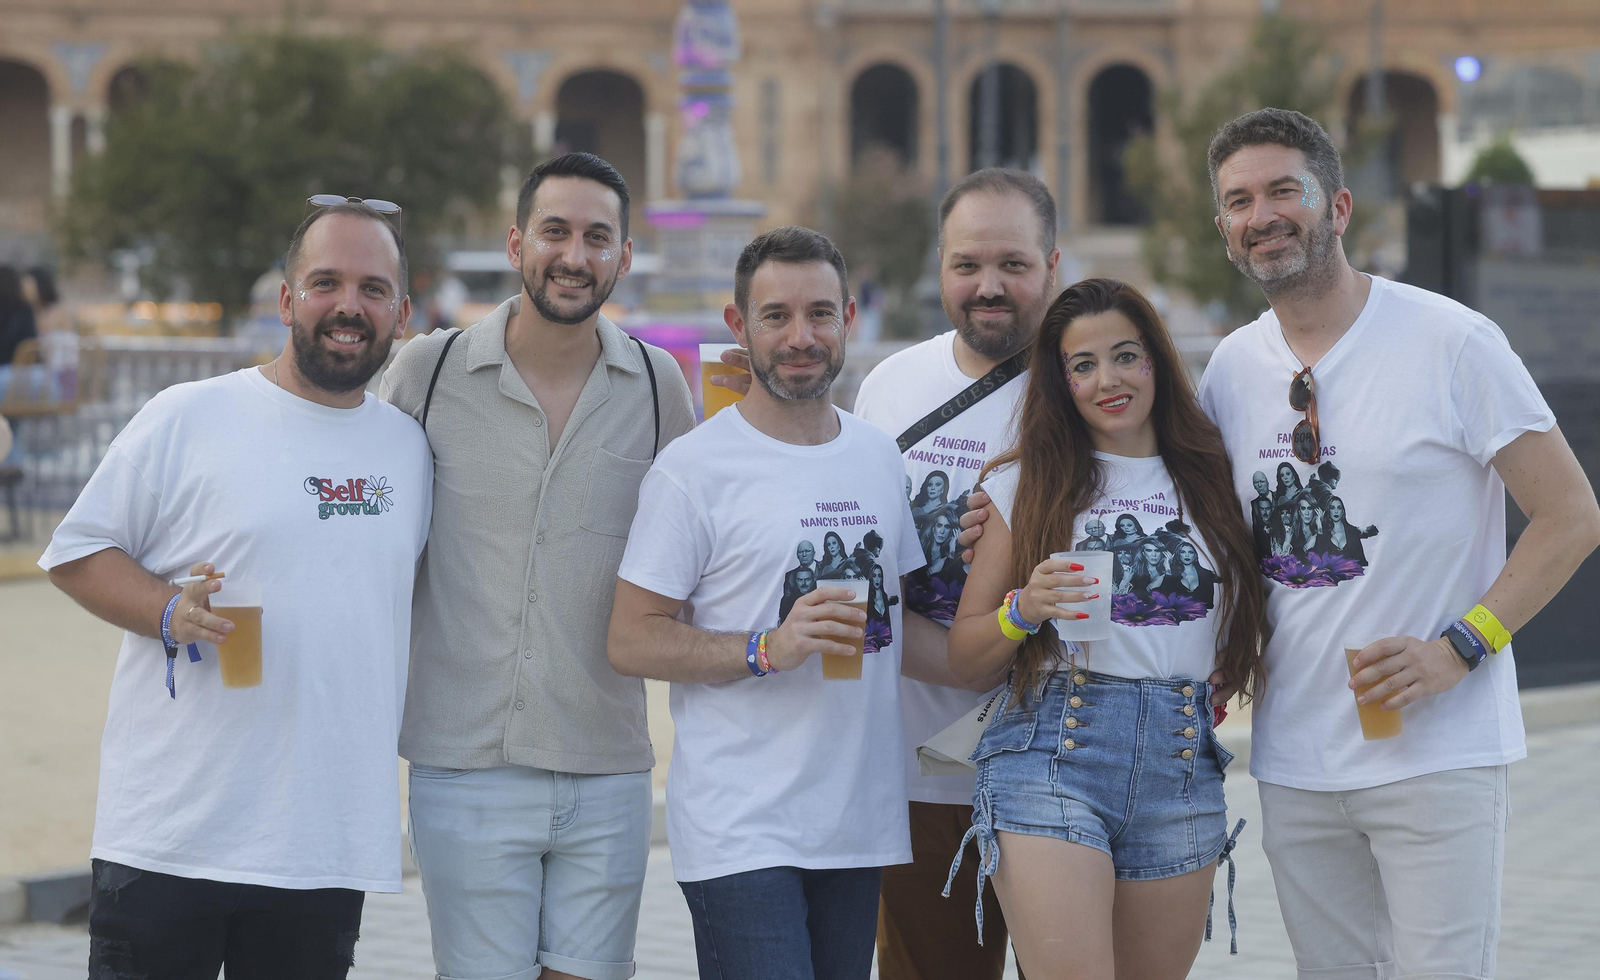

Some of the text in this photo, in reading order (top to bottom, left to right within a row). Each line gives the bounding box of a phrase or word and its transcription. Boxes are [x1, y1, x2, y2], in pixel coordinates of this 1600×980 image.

[941, 368, 1007, 419] GUESS
[932, 435, 986, 453] FANGORIA
[1277, 432, 1321, 443] FANGOR
[908, 449, 999, 473] NANCYS RUBIS
[1259, 448, 1295, 459] NANCYS
[319, 478, 367, 502] Self
[815, 500, 860, 513] FANGORIA
[800, 515, 878, 528] NANCYS RUBIAS
